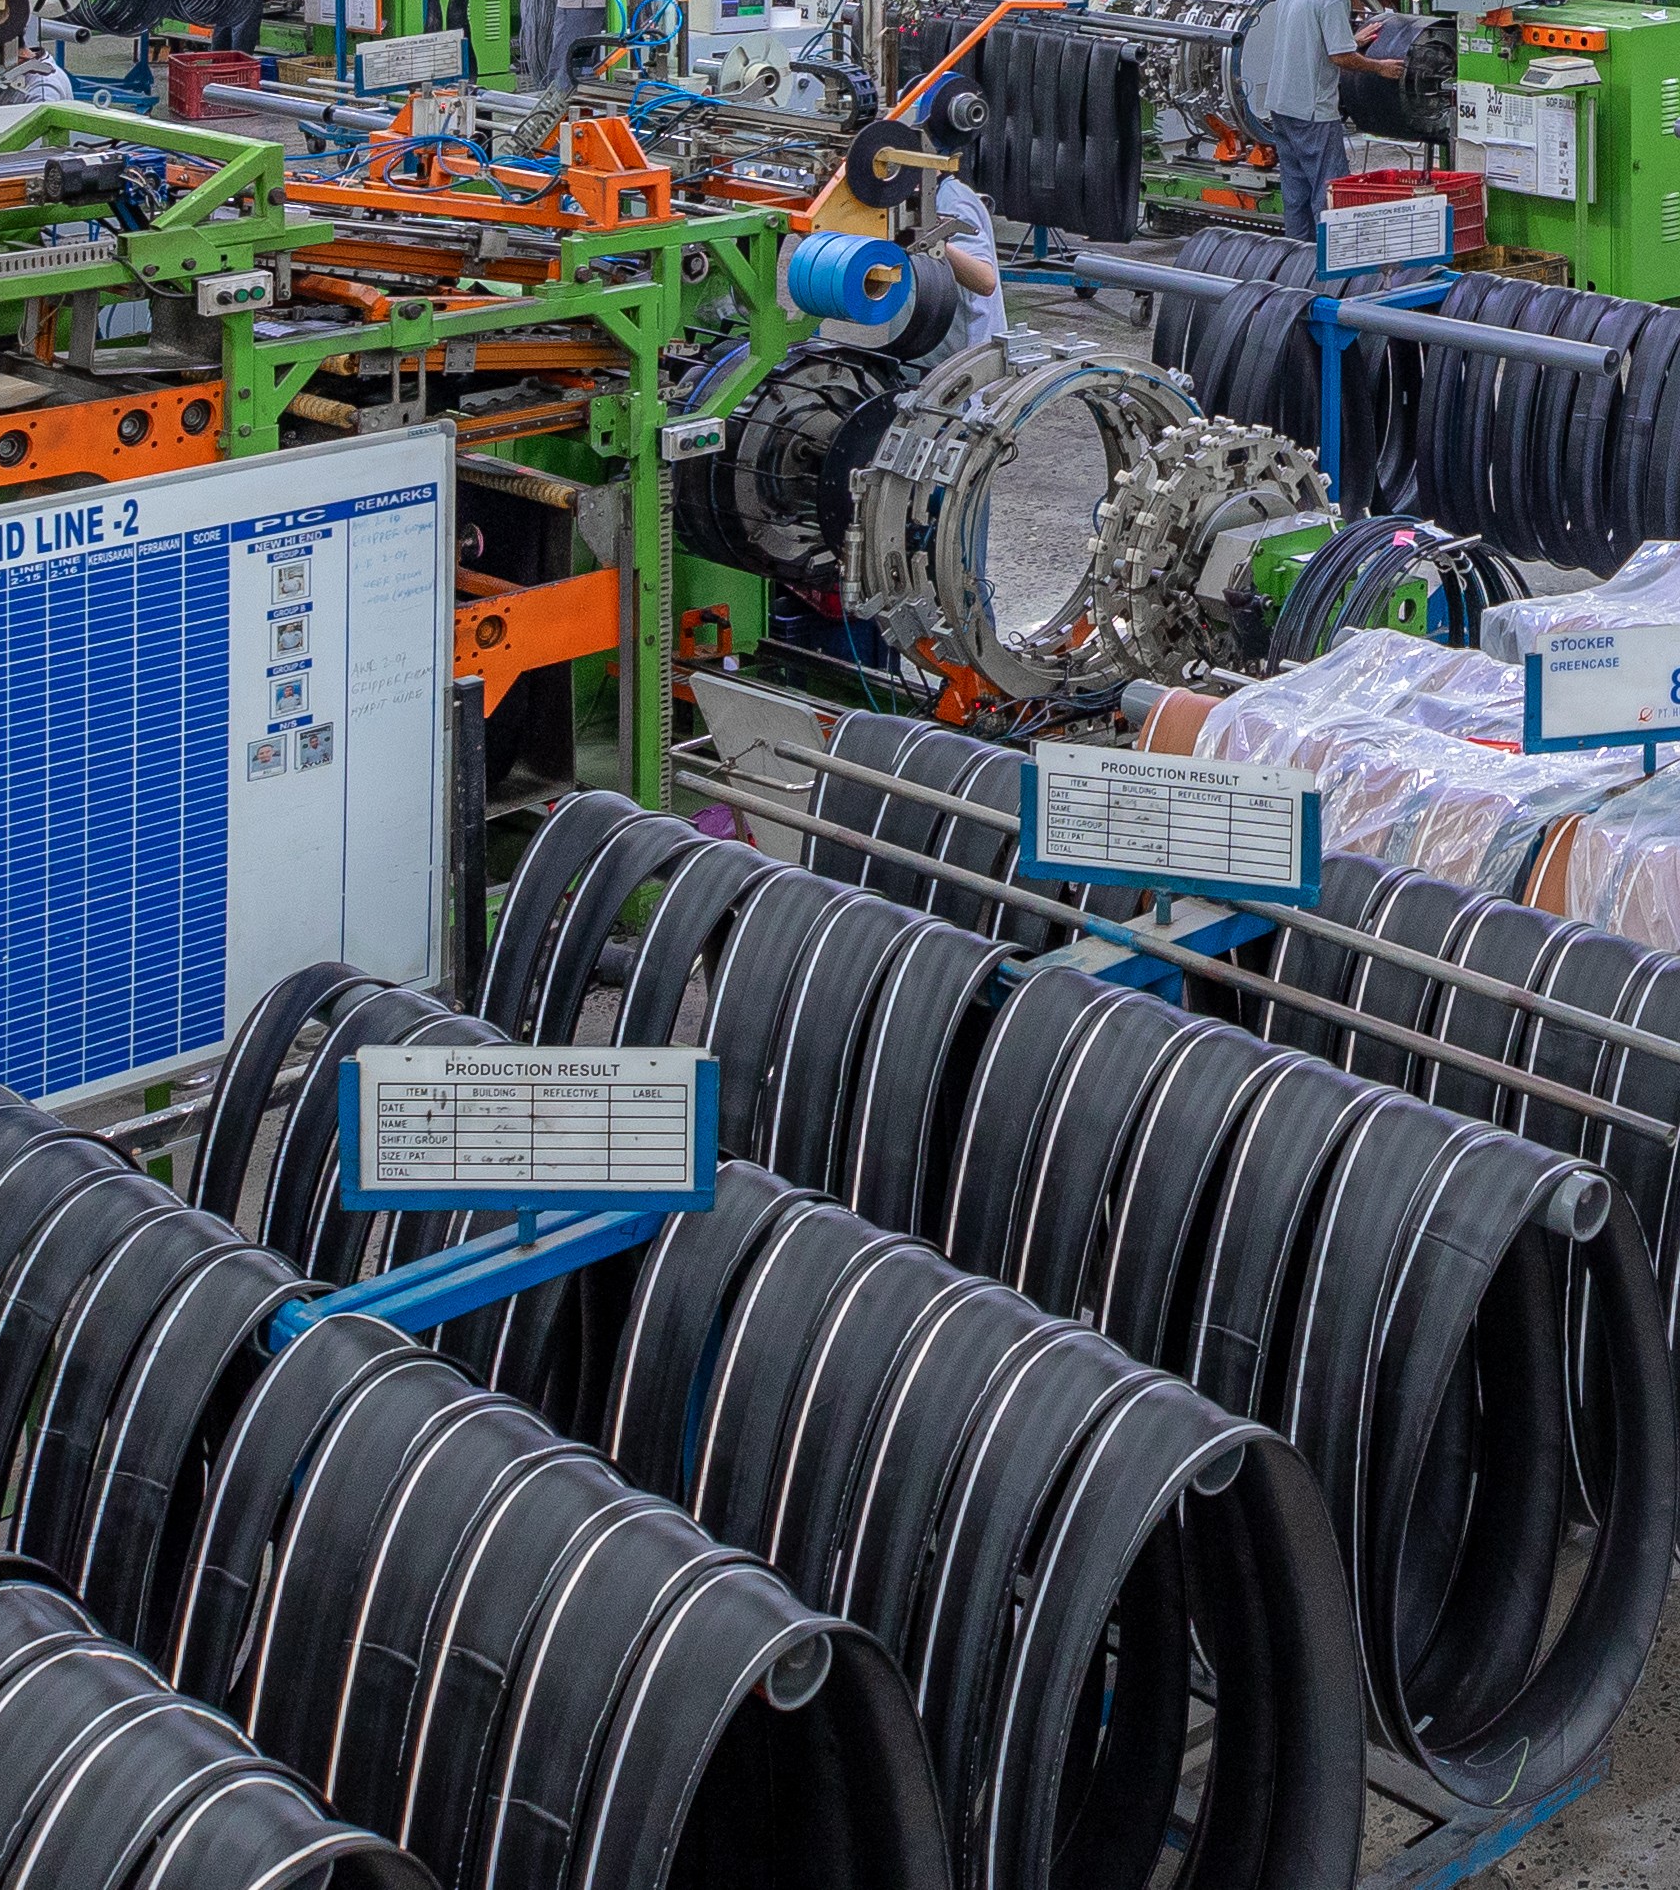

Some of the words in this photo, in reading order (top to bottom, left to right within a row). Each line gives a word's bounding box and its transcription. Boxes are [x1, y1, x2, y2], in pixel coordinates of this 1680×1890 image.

[1487, 88, 1503, 105] 3-12
[1546, 97, 1558, 107] SOP
[1460, 104, 1476, 119] 584
[1487, 105, 1502, 115] AW
[354, 487, 432, 512] REMARKS
[36, 504, 104, 555] LINE
[113, 498, 140, 537] -2
[254, 509, 326, 533] PIC
[192, 528, 221, 545] SCORE
[254, 540, 282, 553] NEW
[285, 537, 298, 547] HI
[300, 531, 323, 544] END
[138, 537, 181, 557] PERBAIKAN
[88, 548, 134, 566] KERUSAKAN
[273, 550, 298, 561] GROUP
[50, 554, 81, 569] LINE
[50, 565, 78, 577] 2-16
[273, 607, 298, 618] GROUP
[1551, 636, 1614, 653] STOCKER
[273, 664, 298, 675] GROUP
[1550, 657, 1619, 672] GREENCASE
[279, 720, 298, 731] N/S
[1100, 762, 1186, 782] PRODUCTION
[1190, 772, 1240, 786] RESULT
[445, 1062, 552, 1077] PRODUCTION
[557, 1063, 620, 1077] RESULT
[406, 1088, 428, 1096] ITEM
[472, 1088, 517, 1098] BUILDING
[543, 1088, 599, 1098] REFLECTIVE
[632, 1089, 662, 1098] LABEL
[381, 1103, 405, 1112] DATE
[381, 1119, 408, 1129] NAME
[381, 1135, 406, 1144] SHIFT
[414, 1135, 448, 1145] GROUP
[381, 1151, 400, 1161] SIZE
[408, 1152, 426, 1161] PAT
[381, 1167, 410, 1177] TOTAL
